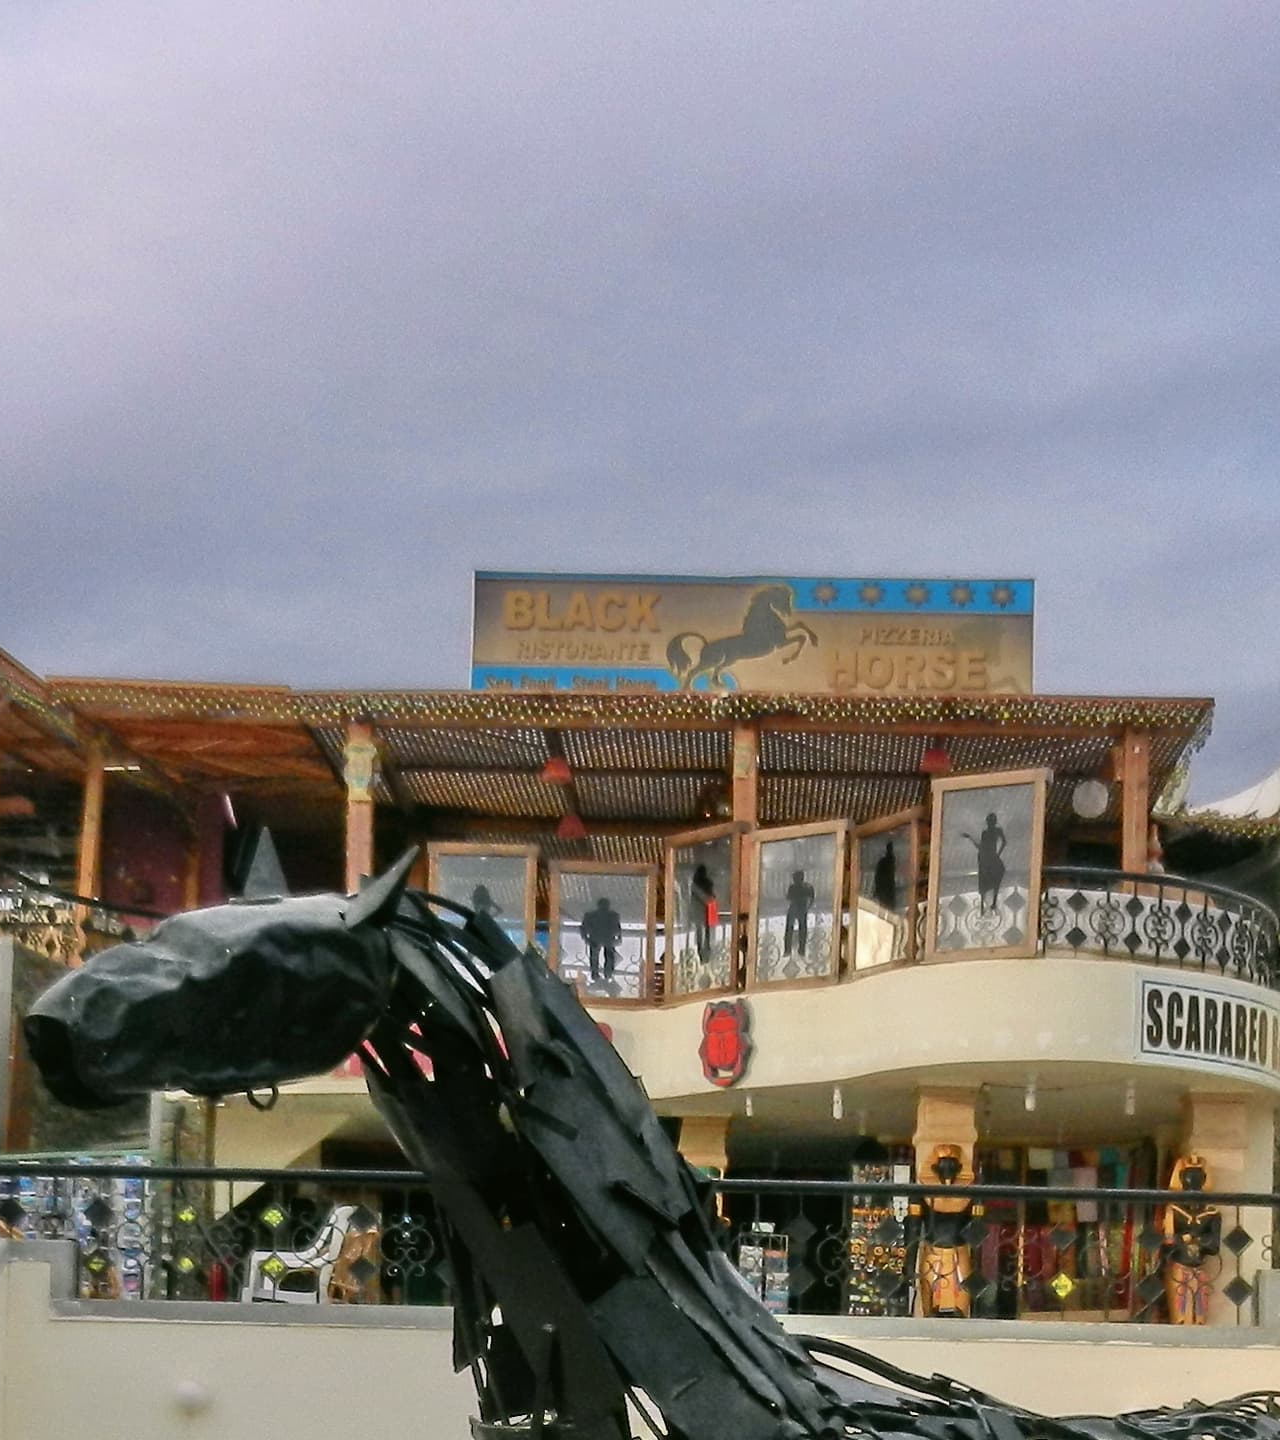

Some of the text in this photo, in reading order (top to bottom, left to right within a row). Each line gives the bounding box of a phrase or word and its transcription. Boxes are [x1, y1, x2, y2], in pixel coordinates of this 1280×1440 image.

[503, 590, 662, 632] BLACK
[517, 639, 651, 661] RISTORANTE
[859, 627, 957, 647] PIZZERIA
[825, 649, 988, 691] HORSE
[1146, 988, 1268, 1066] SCARABEO
